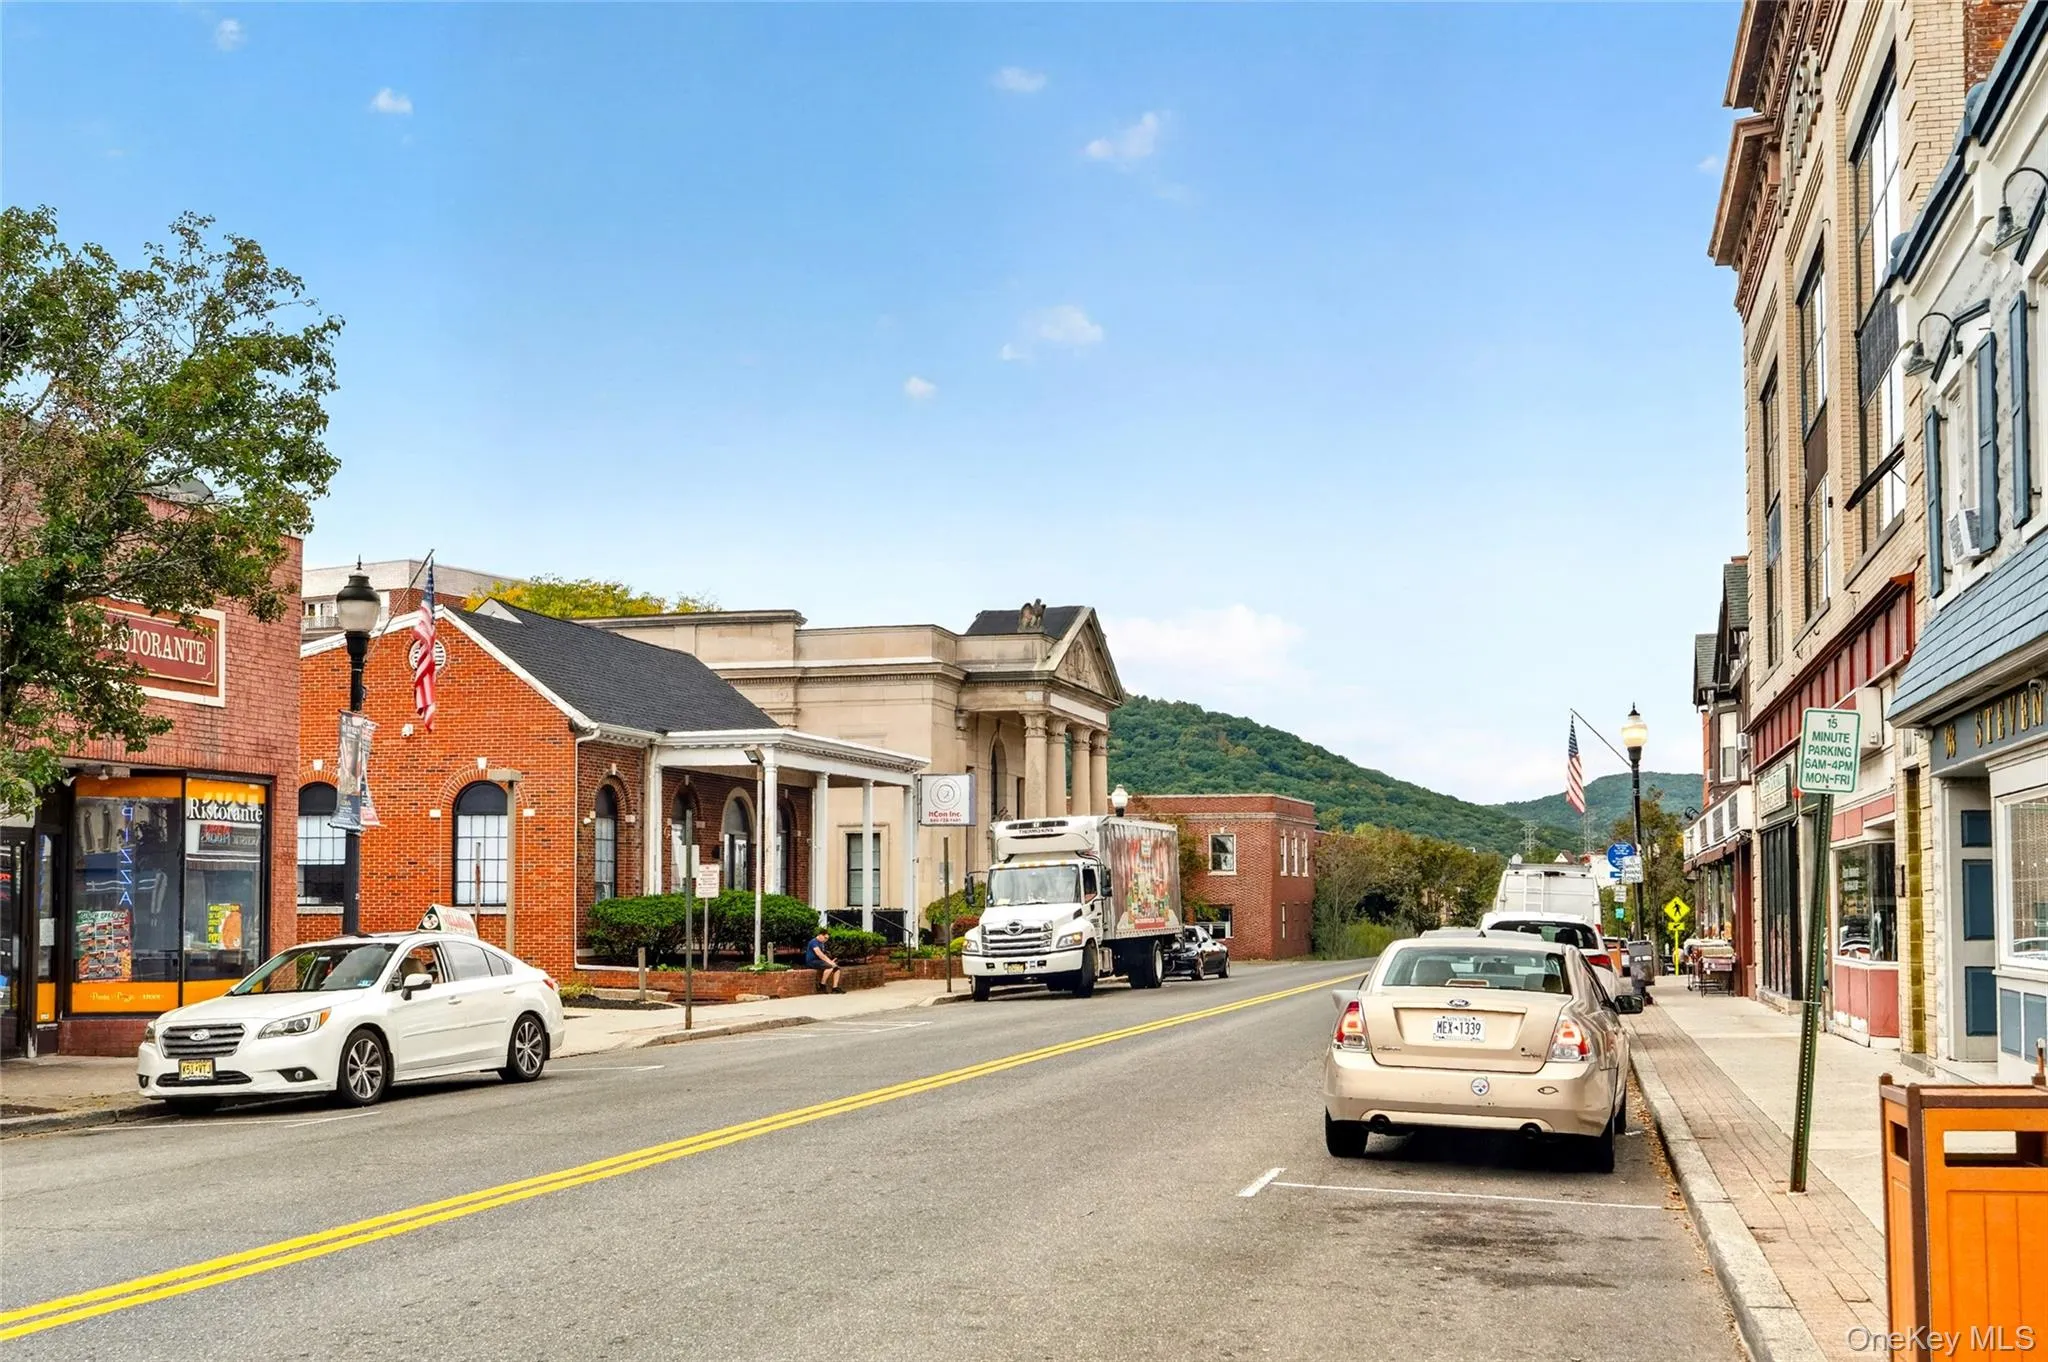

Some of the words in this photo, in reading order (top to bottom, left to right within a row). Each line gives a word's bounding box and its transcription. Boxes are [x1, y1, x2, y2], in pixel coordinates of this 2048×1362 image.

[1827, 718, 1838, 729] 15
[1811, 730, 1850, 744] MINUTE
[1808, 744, 1852, 758] PARKING
[1805, 758, 1853, 772] 6AM-4PM
[1805, 772, 1850, 786] MON-FRI
[188, 797, 263, 823] Ristorante
[1436, 1020, 1453, 1034] MEX
[1459, 1022, 1481, 1035] 1339
